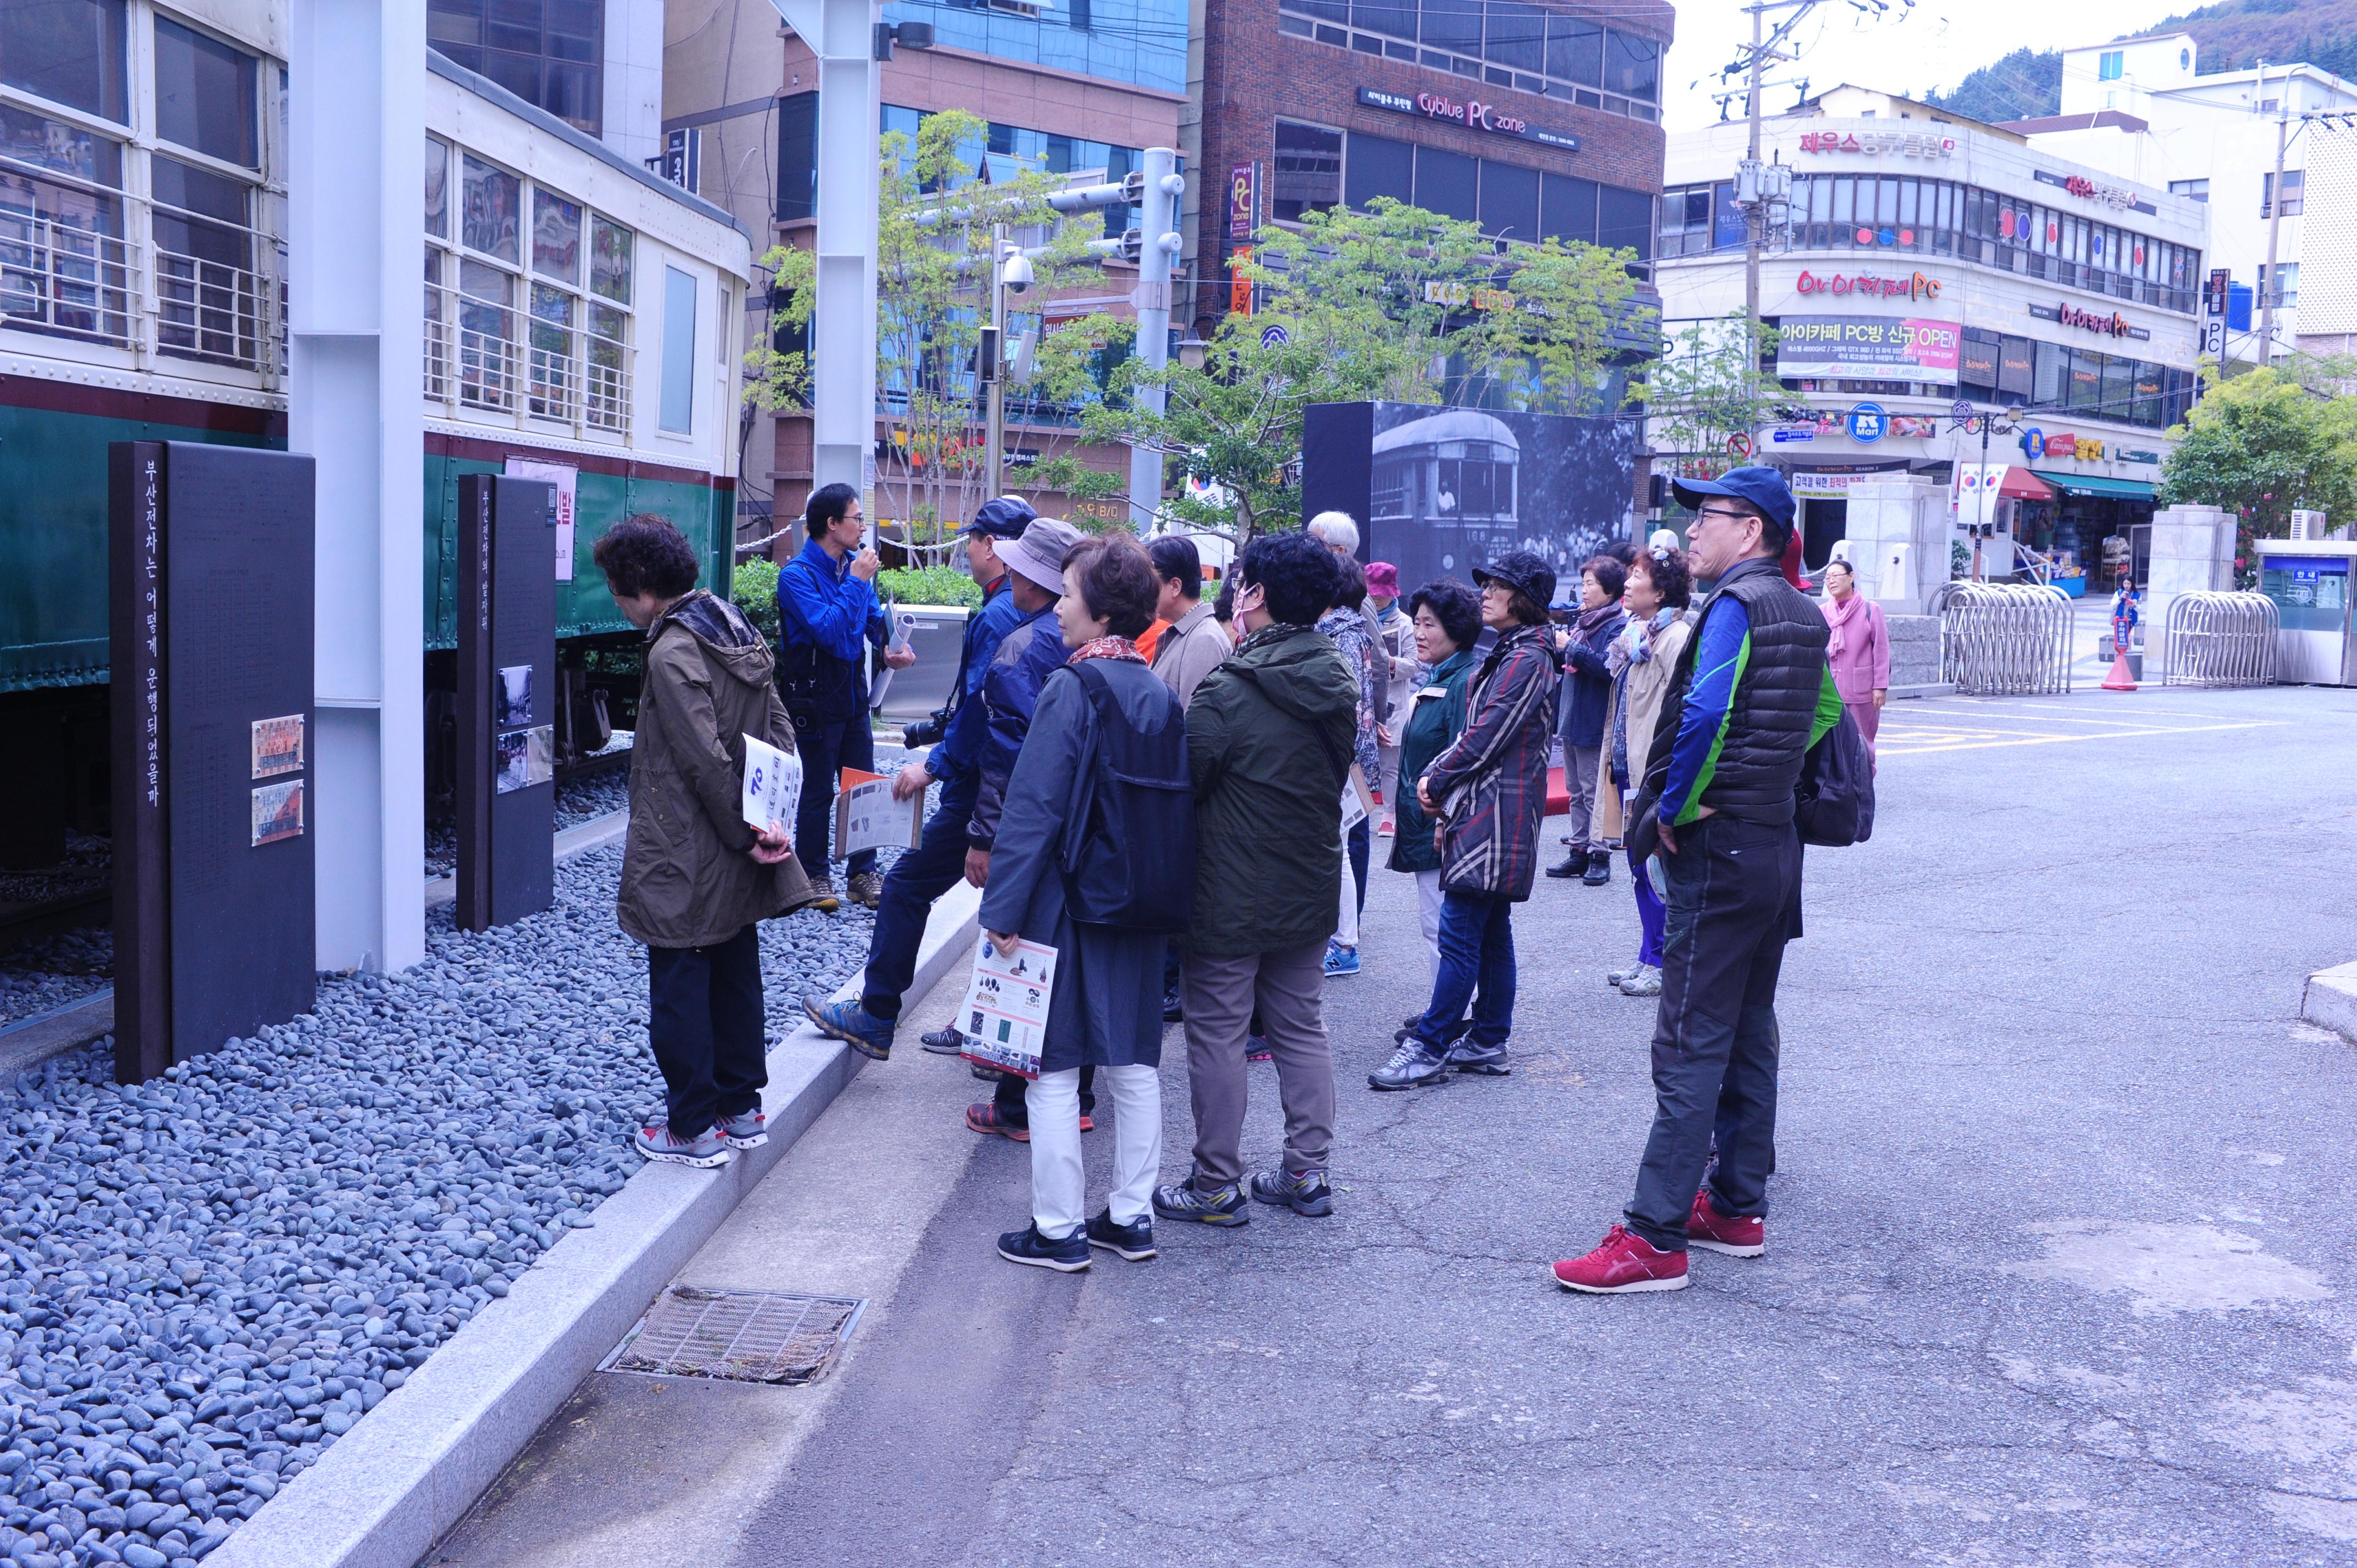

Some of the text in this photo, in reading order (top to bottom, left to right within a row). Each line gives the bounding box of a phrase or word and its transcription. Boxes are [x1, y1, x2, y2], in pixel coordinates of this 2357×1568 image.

[1418, 93, 1464, 118] Cyblue
[1467, 101, 1492, 131] PC
[1495, 116, 1526, 133] zone
[1234, 178, 1250, 211] PC
[1233, 213, 1249, 221] zone
[1781, 323, 1957, 349] 아이카페 PC방 신규 OPEN
[2207, 323, 2221, 352] PC
[1855, 366, 1876, 375] 사양과
[2050, 438, 2074, 453] Campus
[1795, 476, 1813, 487] 고객을
[1815, 477, 1828, 488] 위한
[1829, 477, 1847, 488] 최적의
[1099, 506, 1118, 517] B/D
[145, 460, 158, 807] 부산전차는 어떻게 운행되었을까
